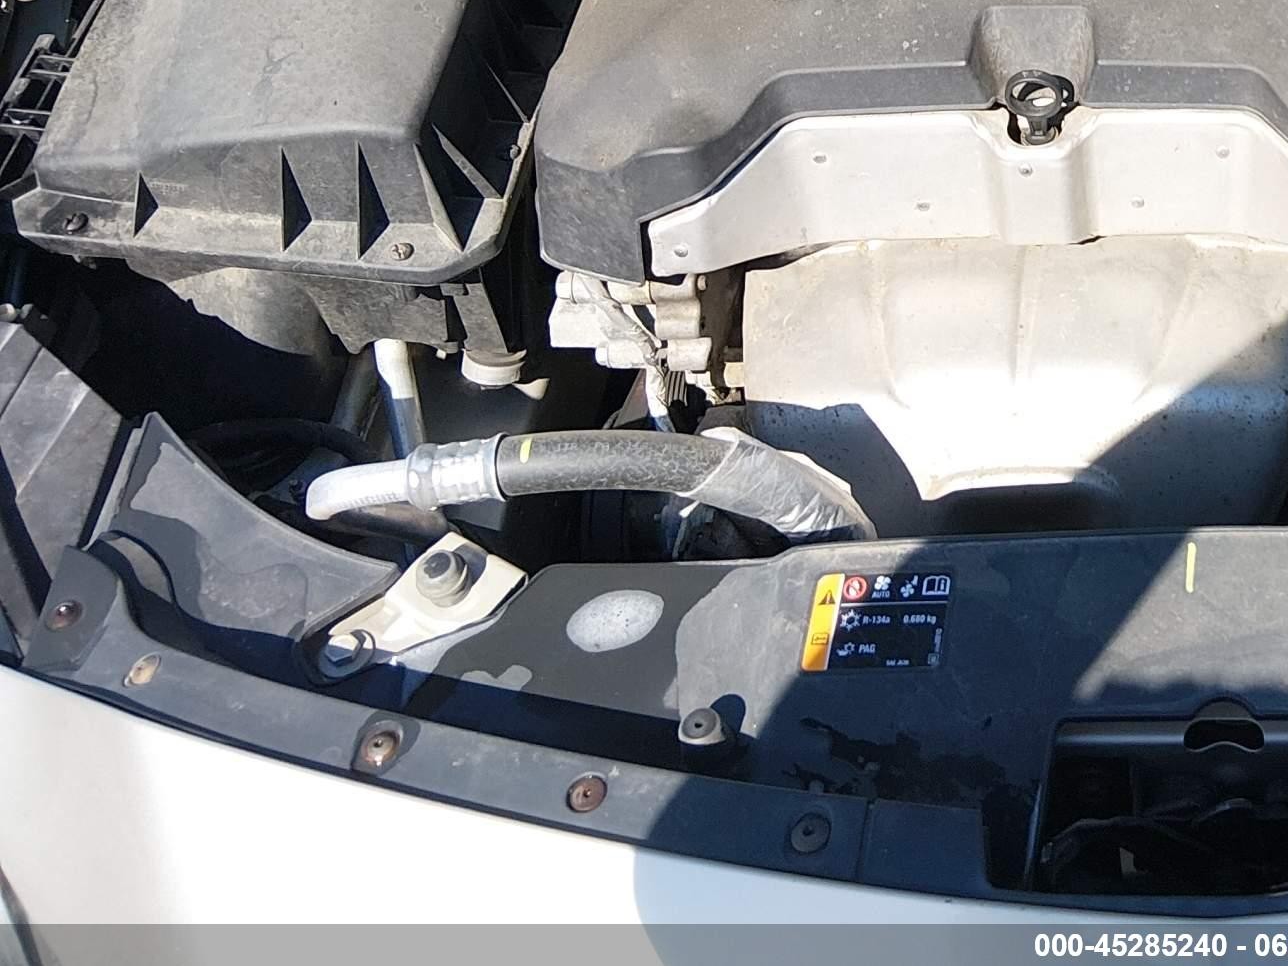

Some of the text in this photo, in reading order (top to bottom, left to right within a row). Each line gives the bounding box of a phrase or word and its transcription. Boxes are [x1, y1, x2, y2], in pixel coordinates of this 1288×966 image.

[872, 590, 890, 599] AUTO
[863, 614, 891, 624] R-134a
[926, 614, 937, 625] kg
[858, 643, 876, 654] PAG
